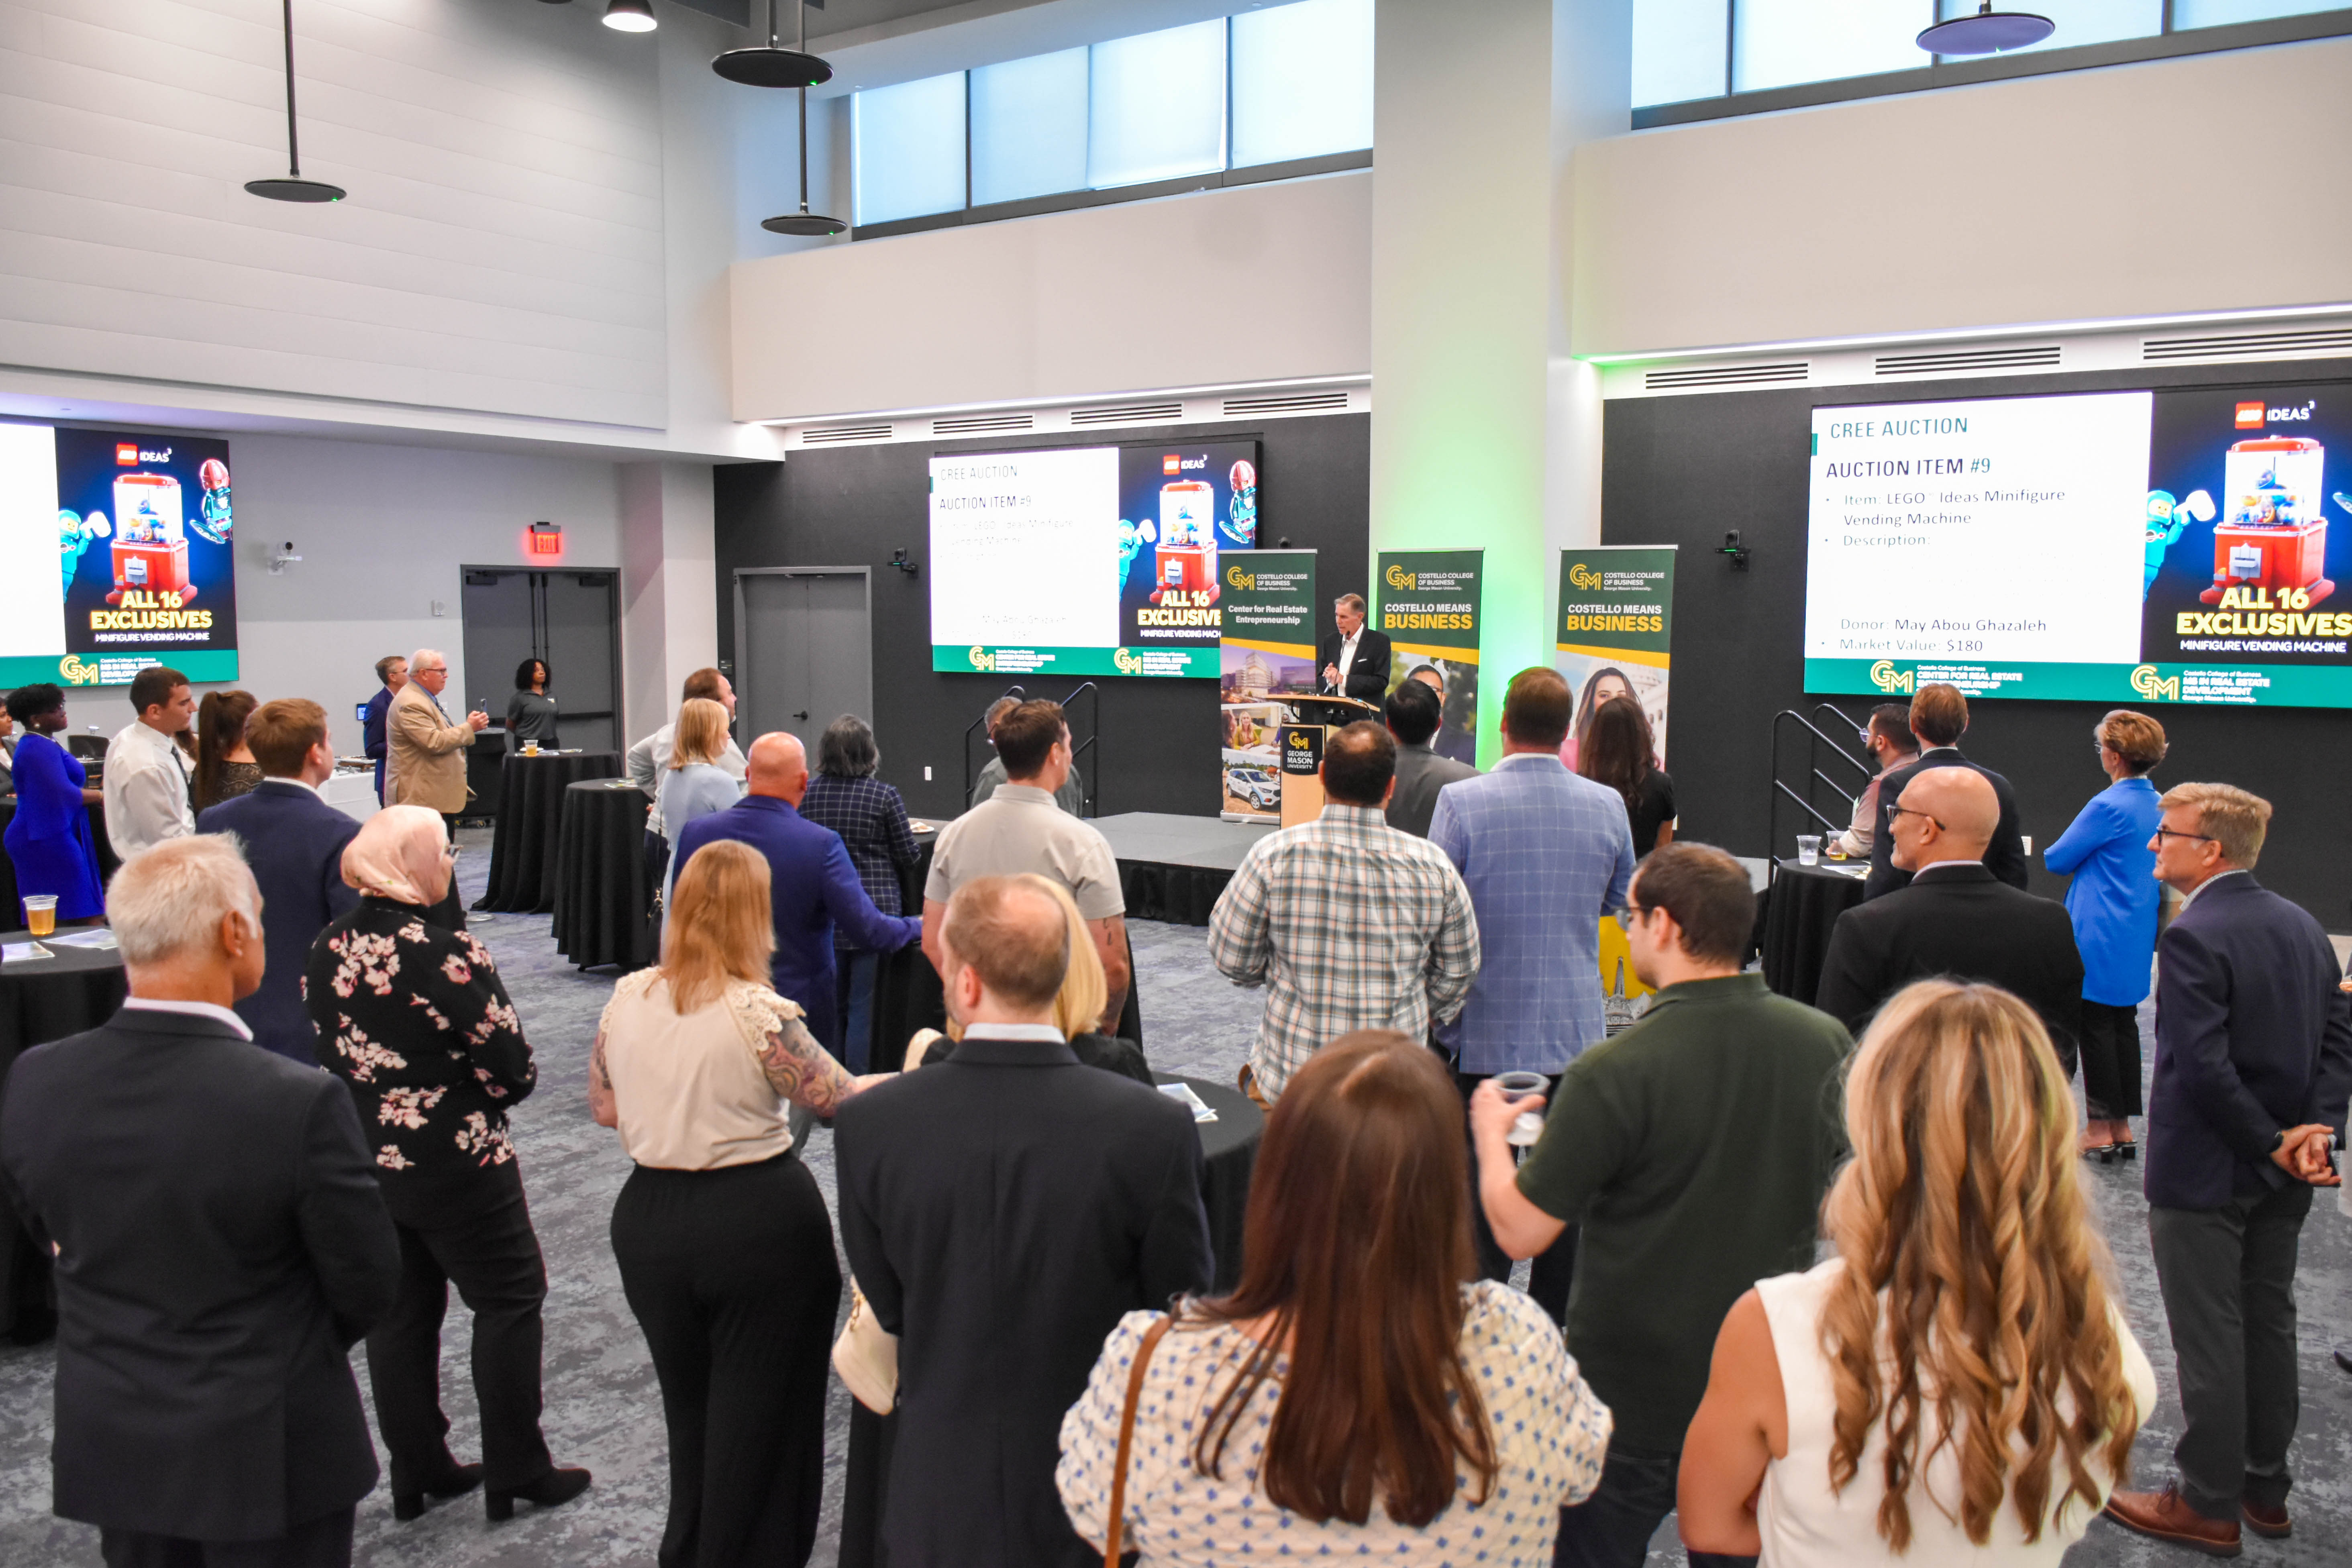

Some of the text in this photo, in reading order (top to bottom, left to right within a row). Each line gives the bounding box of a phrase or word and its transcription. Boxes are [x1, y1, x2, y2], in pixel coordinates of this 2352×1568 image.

[2267, 408, 2309, 421] IDEAS
[1831, 418, 1967, 438] CREE AUCTION
[139, 451, 169, 463] IDEAS
[1181, 459, 1205, 469] IDEAS
[941, 466, 1017, 480] CREE AUCTION
[1826, 458, 1991, 478] AUCTION ITEM #9
[940, 497, 986, 510] AUCTION
[991, 496, 1016, 508] ITEM
[1844, 494, 1882, 505] Item:
[1940, 491, 1979, 503] Ideas
[1985, 489, 2065, 504] Minifigure
[1844, 512, 1972, 528] Vending Machine
[537, 535, 557, 553] EXIT
[1844, 534, 1930, 548] Description:
[121, 591, 183, 608] ALL 16
[1160, 591, 1210, 607] ALL 16
[2219, 587, 2310, 610] ALL 16
[1385, 604, 1472, 612] COSTELLO MEANS
[1568, 605, 1662, 614] COSTELLO MEANS
[91, 611, 212, 629] EXCLUSIVES
[1138, 609, 1221, 626] EXCLUSIVE
[1236, 616, 1300, 625] Entrepreneurship
[1384, 614, 1473, 629] BUSINESS
[1567, 615, 1663, 632] BUSINESS
[2177, 612, 2352, 636] EXCLUSIVES
[1895, 619, 1926, 632] May
[1931, 619, 1970, 631] Abou
[1976, 619, 2046, 631] Ghazaleh
[96, 633, 210, 642] MINIFIGURE VENDING MACHINE
[1840, 639, 1891, 650] Market
[1947, 639, 1983, 652] $180
[2180, 640, 2347, 652] MINIFIGURE VENDING MACHINE
[1289, 731, 1309, 750] GM
